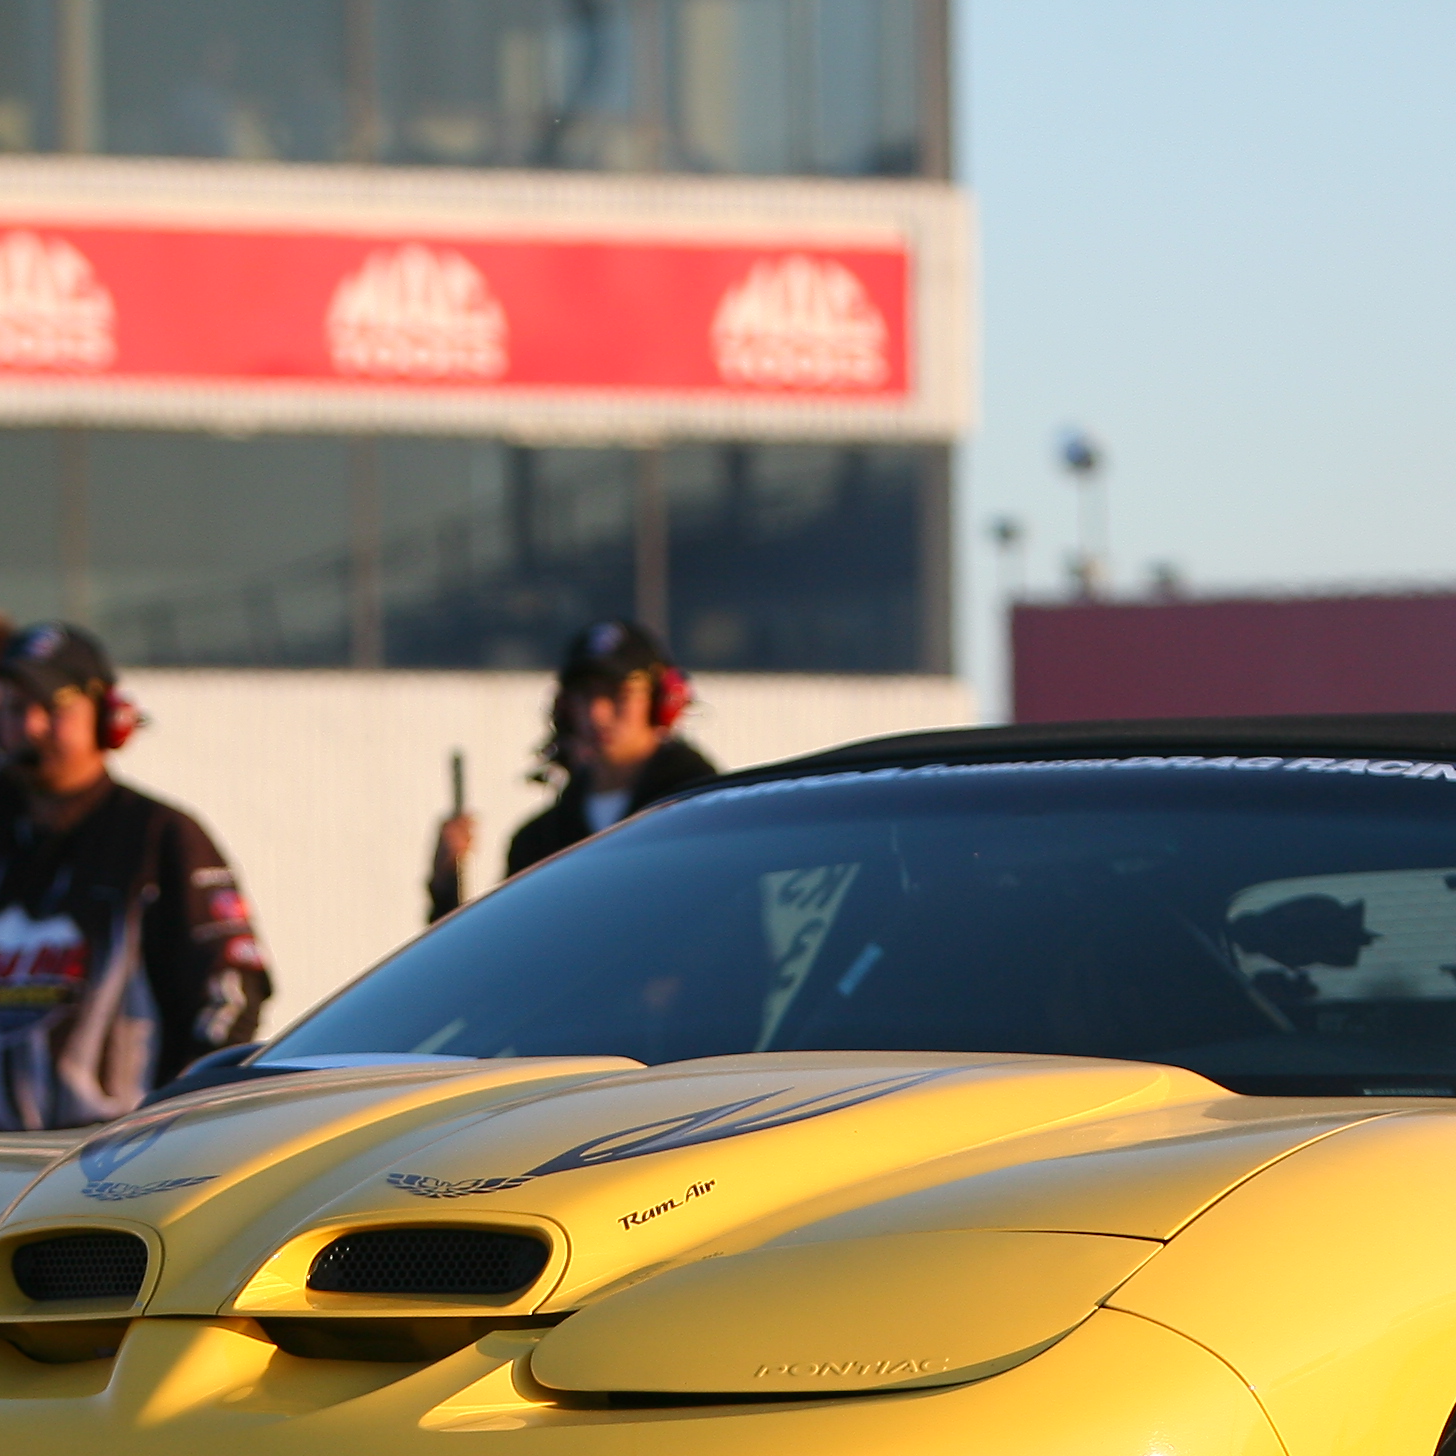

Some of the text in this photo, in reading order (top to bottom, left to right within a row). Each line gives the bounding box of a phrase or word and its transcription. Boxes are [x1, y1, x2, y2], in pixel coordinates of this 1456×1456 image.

[1111, 755, 1285, 771] DRAG
[617, 1179, 715, 1231] Ram Air
[752, 1357, 951, 1379] PONTIAC
